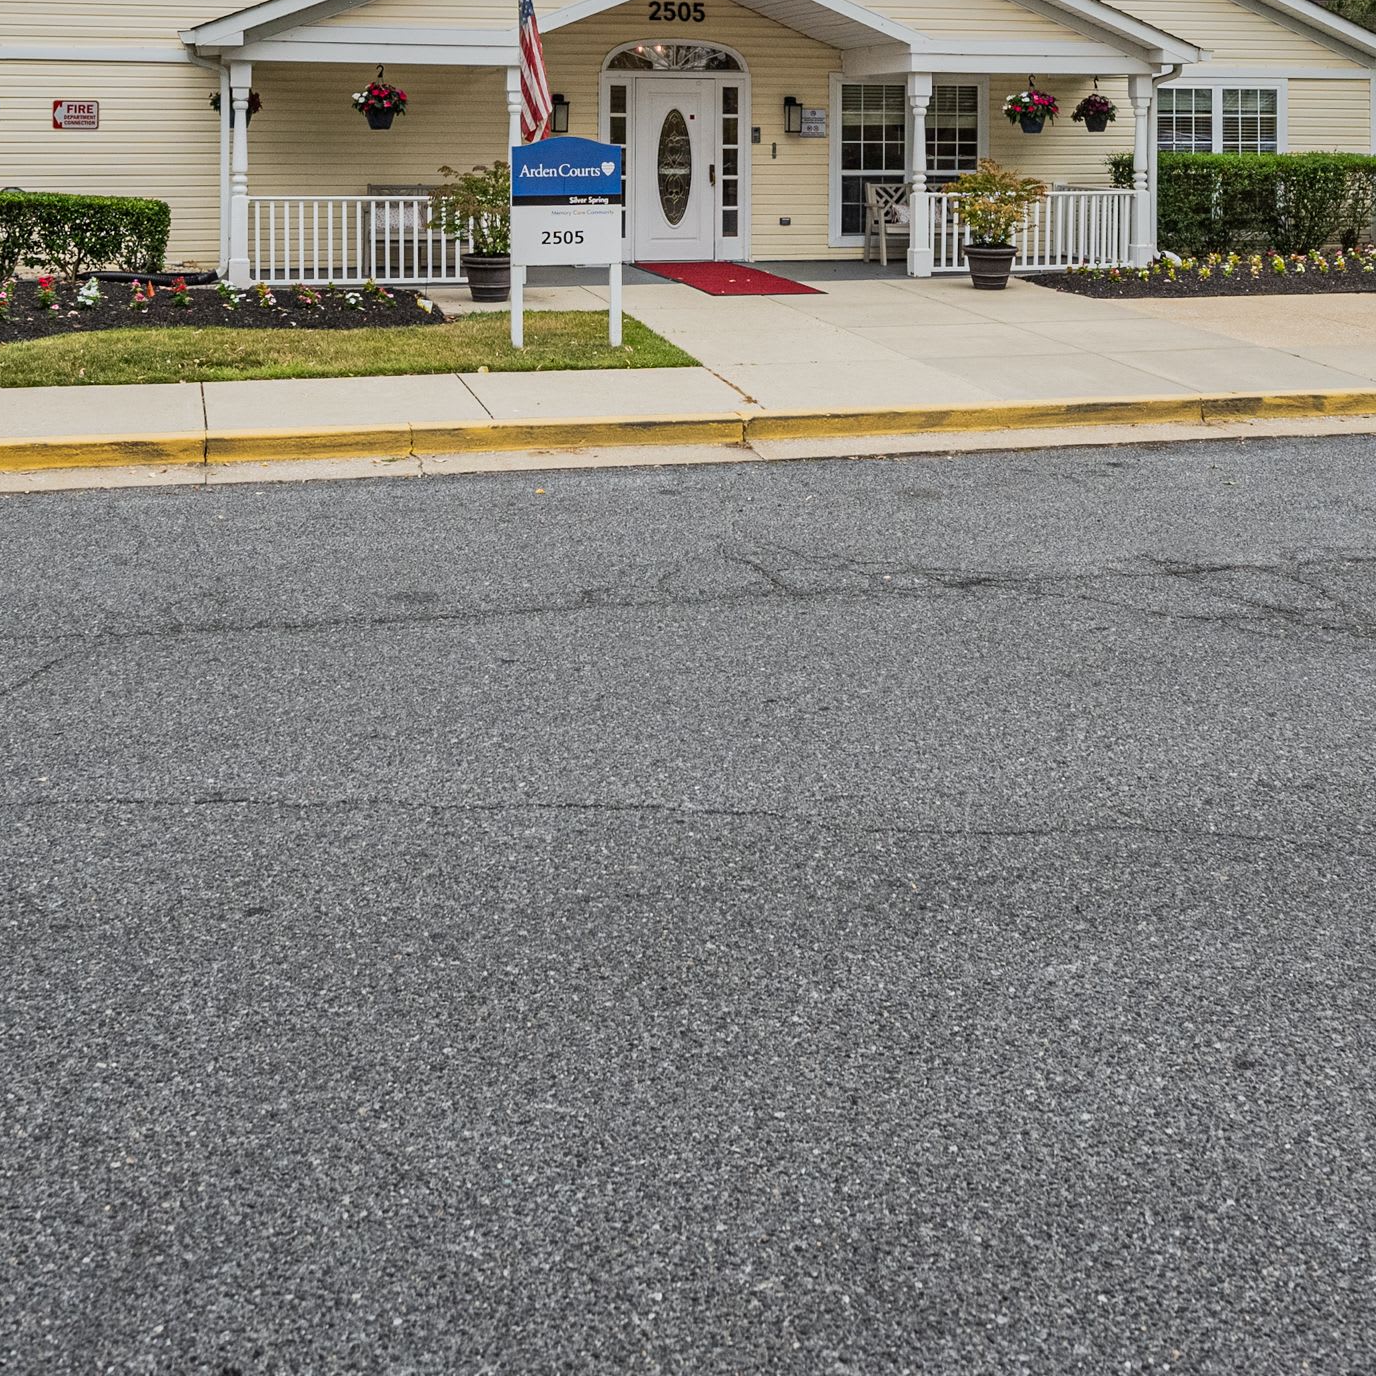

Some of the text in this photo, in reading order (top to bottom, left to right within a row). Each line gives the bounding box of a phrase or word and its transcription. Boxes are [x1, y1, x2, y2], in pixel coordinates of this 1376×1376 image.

[648, 0, 705, 22] 2505
[66, 104, 94, 114] FIRE
[519, 164, 558, 178] Arden
[558, 163, 601, 177] Courts
[568, 195, 609, 205] Silver Spring
[541, 230, 584, 245] 2505
